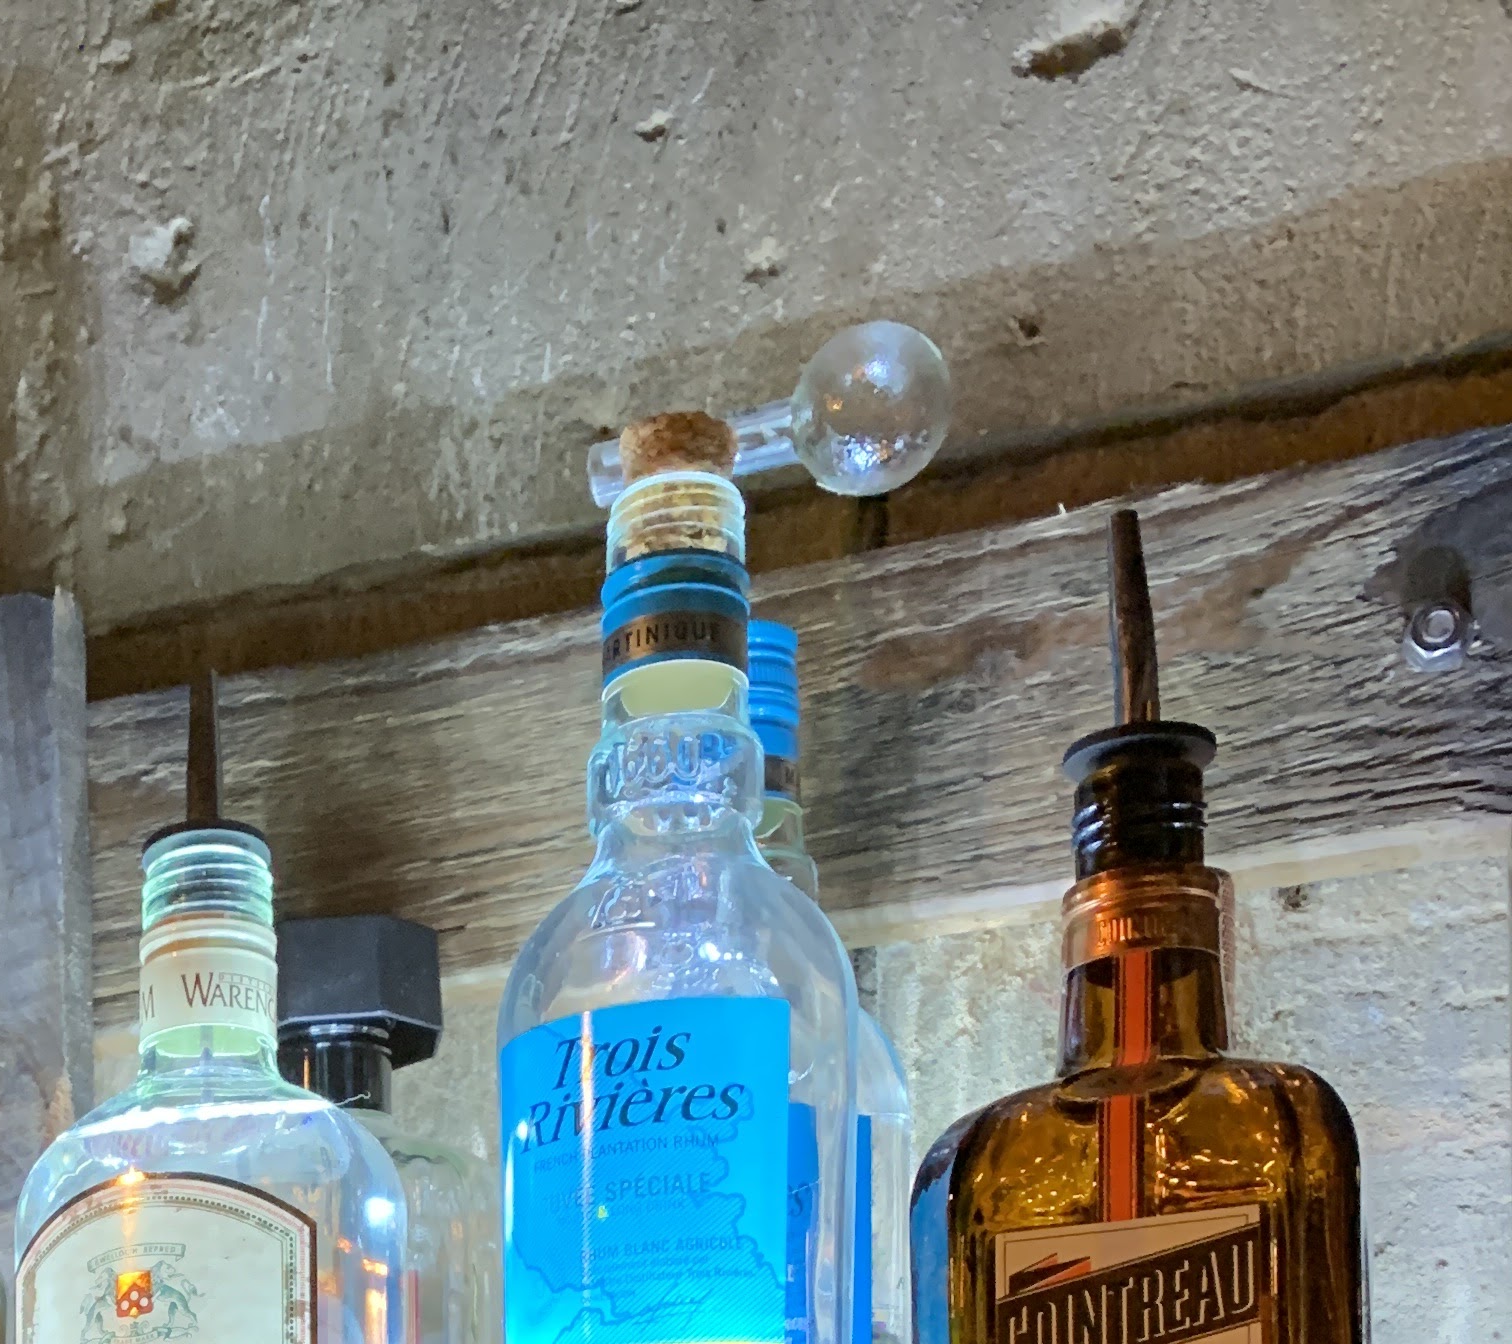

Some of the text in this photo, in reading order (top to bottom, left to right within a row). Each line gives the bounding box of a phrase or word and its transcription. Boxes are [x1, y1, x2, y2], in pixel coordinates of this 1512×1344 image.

[552, 1024, 692, 1091] Trois
[520, 1076, 747, 1156] Rivières
[581, 1135, 669, 1161] LANTATION
[673, 1133, 720, 1150] RHUM
[604, 1171, 712, 1203] SPÉCIALE
